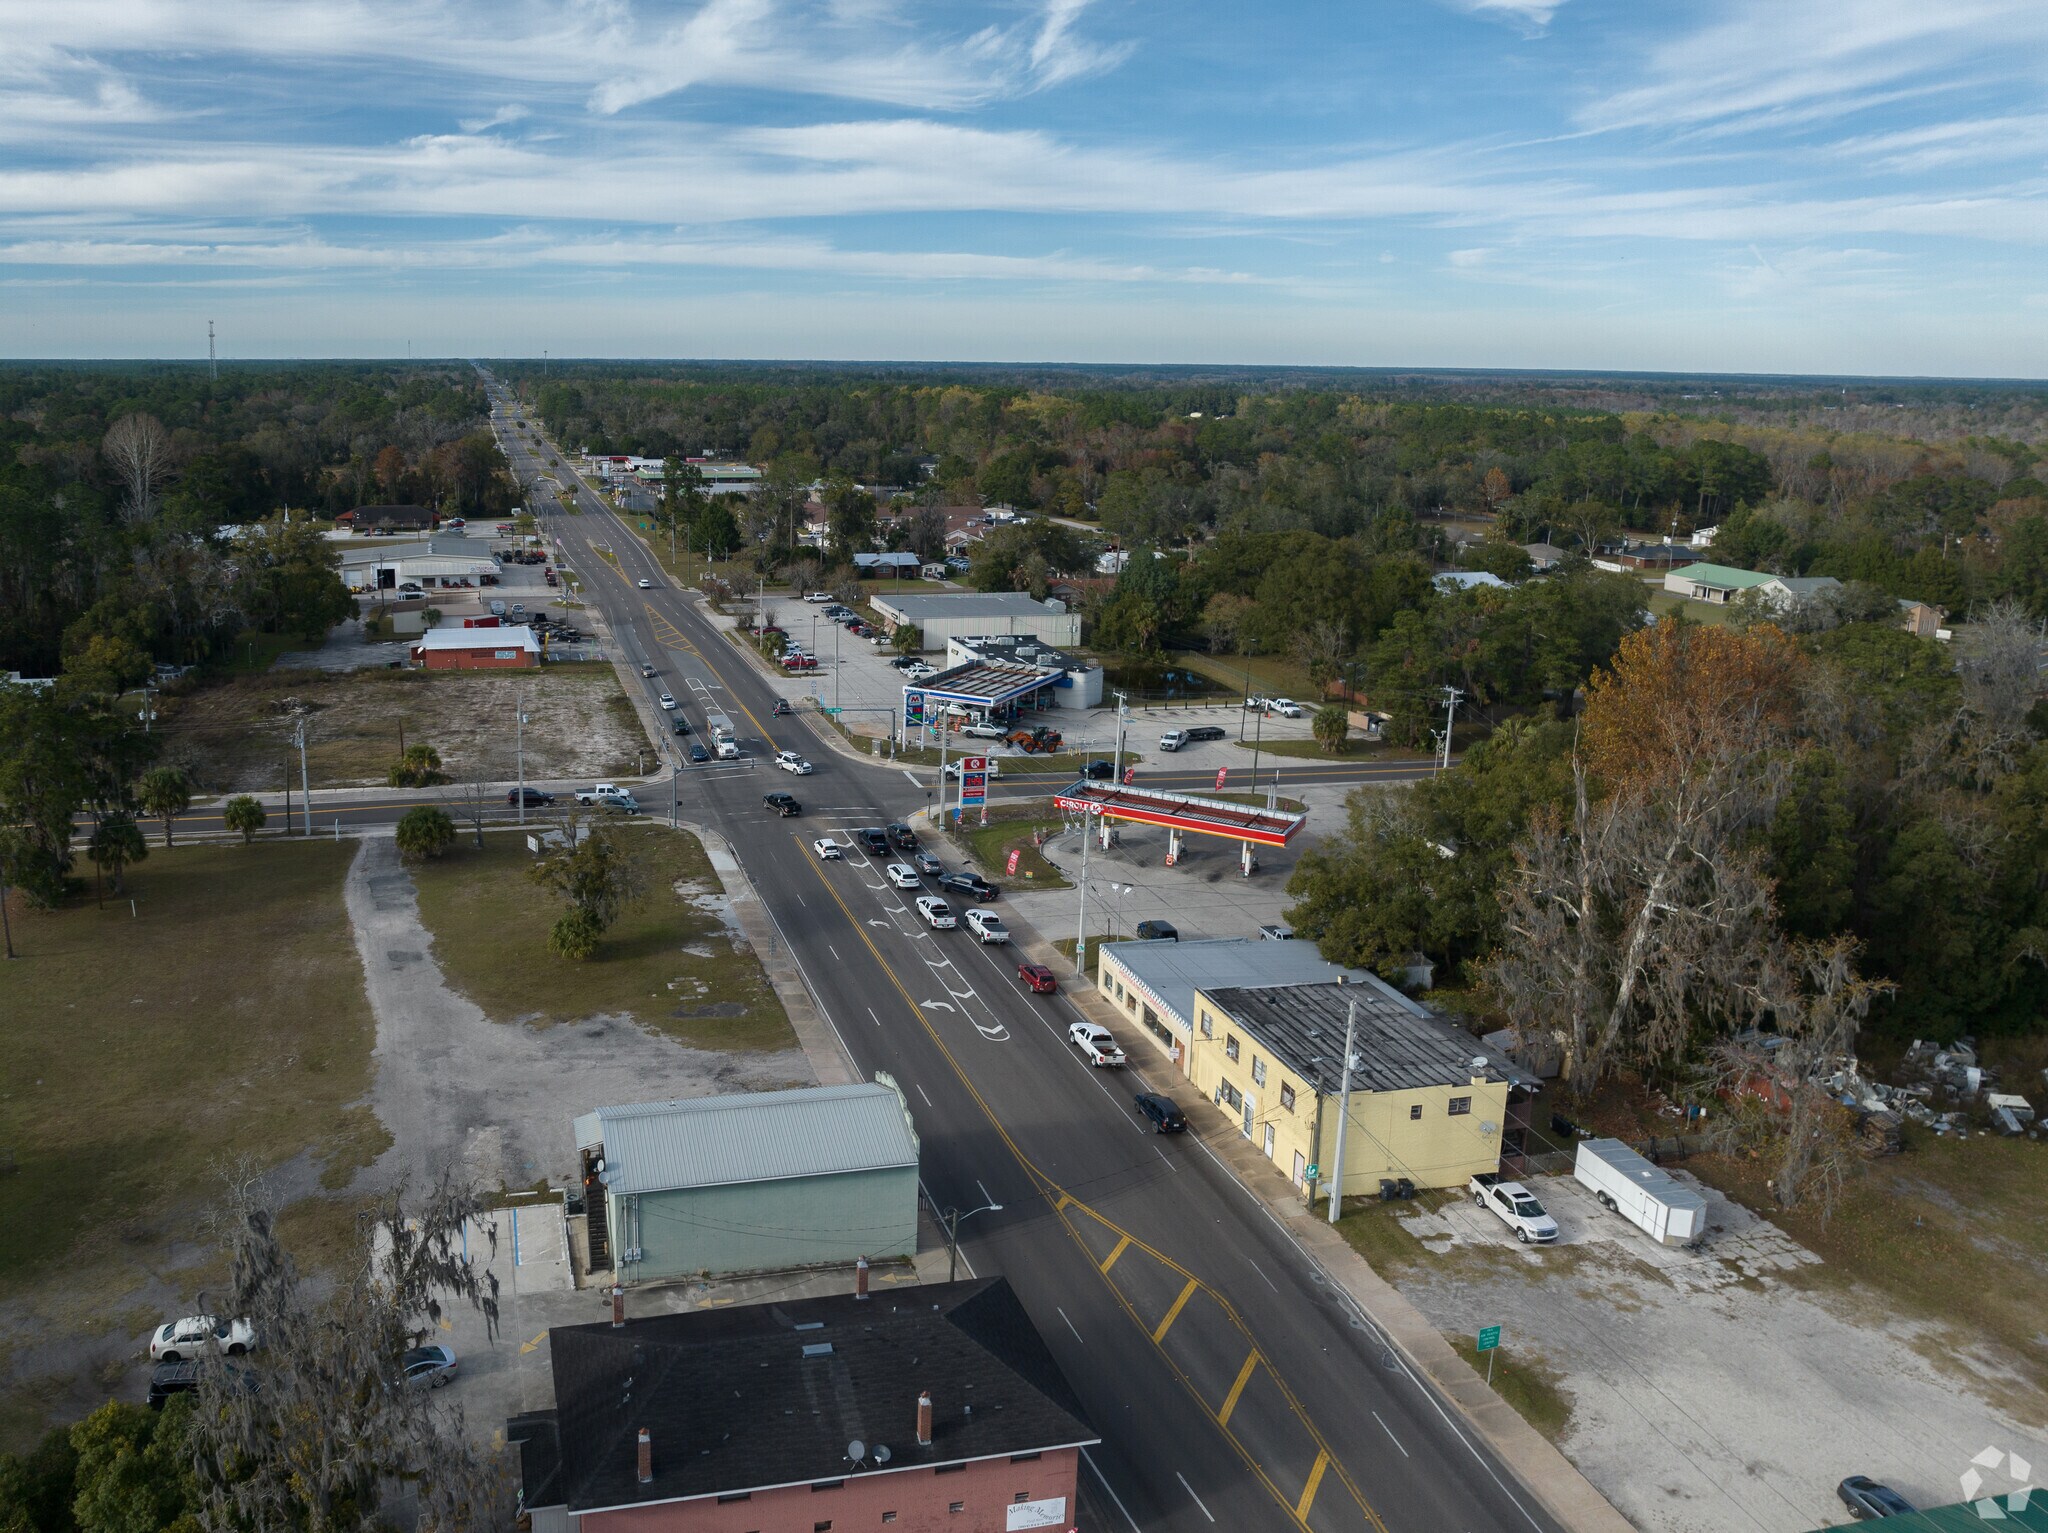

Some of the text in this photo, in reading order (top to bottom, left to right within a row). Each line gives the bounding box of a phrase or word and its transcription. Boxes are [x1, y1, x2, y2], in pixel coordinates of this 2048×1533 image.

[1060, 799, 1089, 811] CIRCLE
[1008, 1504, 1064, 1520] Making Memories
